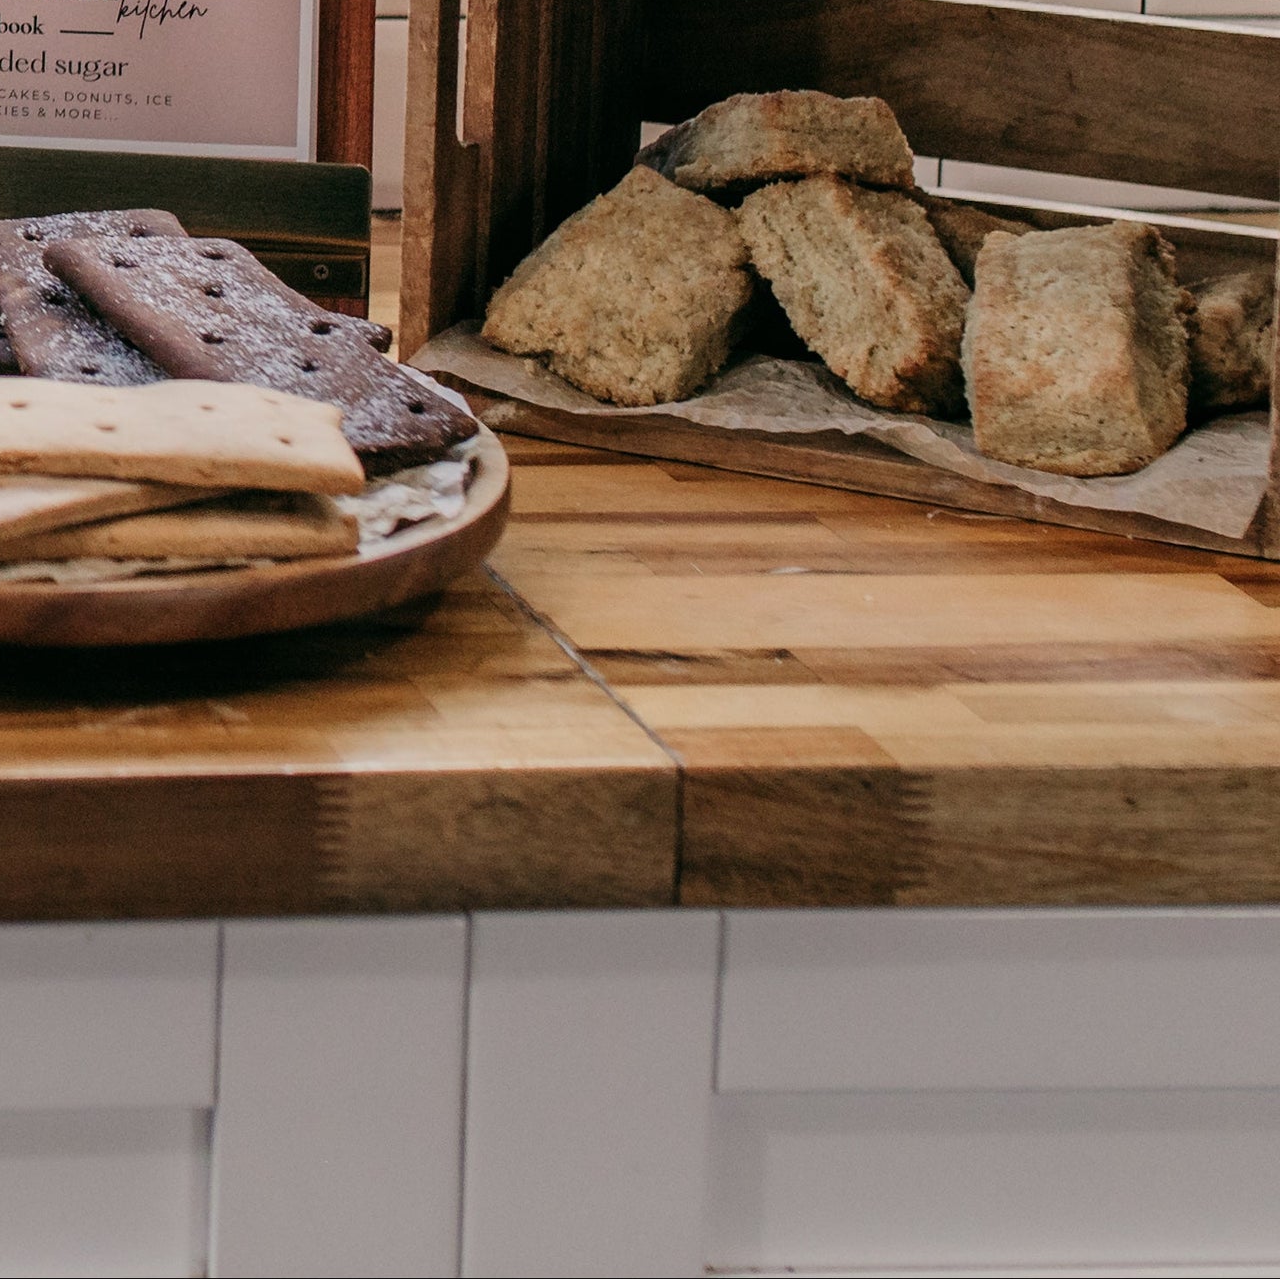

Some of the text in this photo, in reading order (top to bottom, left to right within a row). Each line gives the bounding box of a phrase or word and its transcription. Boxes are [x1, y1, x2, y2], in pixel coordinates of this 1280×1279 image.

[54, 58, 129, 83] sugar
[64, 91, 138, 106] DONUTS,
[146, 94, 173, 107] ICE
[38, 106, 47, 118] &
